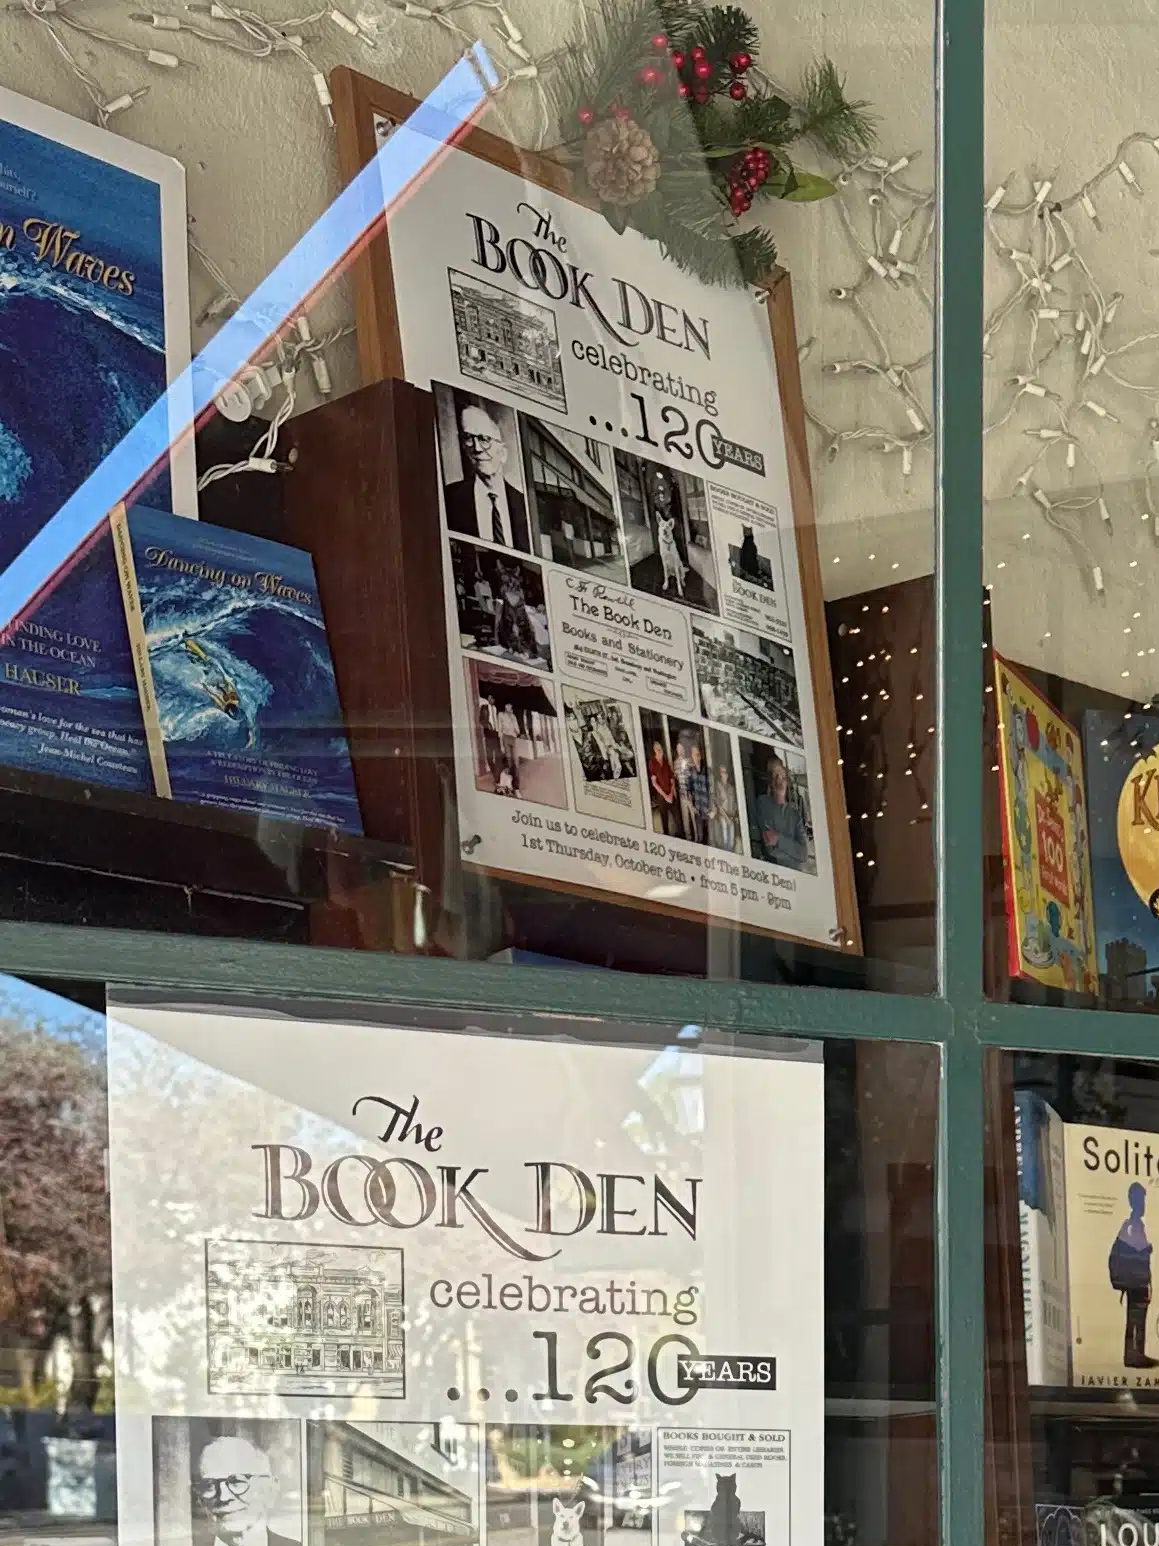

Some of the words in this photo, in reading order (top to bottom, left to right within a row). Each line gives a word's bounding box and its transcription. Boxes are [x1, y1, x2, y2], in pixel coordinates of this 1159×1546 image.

[517, 202, 568, 253] The
[465, 213, 640, 347] BOOK
[612, 278, 711, 361] DEN
[571, 339, 719, 418] celebrating
[569, 595, 599, 620] The
[602, 607, 640, 631] Book
[643, 618, 672, 640] Den
[562, 622, 599, 645] Books
[602, 636, 623, 651] and
[627, 642, 685, 670] Stationery
[511, 810, 542, 829] Join
[543, 819, 561, 833] us
[564, 821, 578, 835] to
[580, 826, 639, 852] celebrate
[643, 840, 666, 858] 120
[668, 849, 701, 871] years
[704, 856, 717, 870] of
[718, 859, 740, 877] The
[742, 864, 770, 885] Book
[771, 870, 796, 892] Den!
[350, 1094, 445, 1153] The
[250, 1143, 564, 1262] BOOK
[524, 1160, 704, 1242] DEN
[429, 1273, 699, 1326] celebrating
[663, 1432, 699, 1440] BOOKS
[702, 1433, 745, 1442] BOUGHT
[748, 1434, 756, 1442] &
[759, 1434, 785, 1442] SOLD
